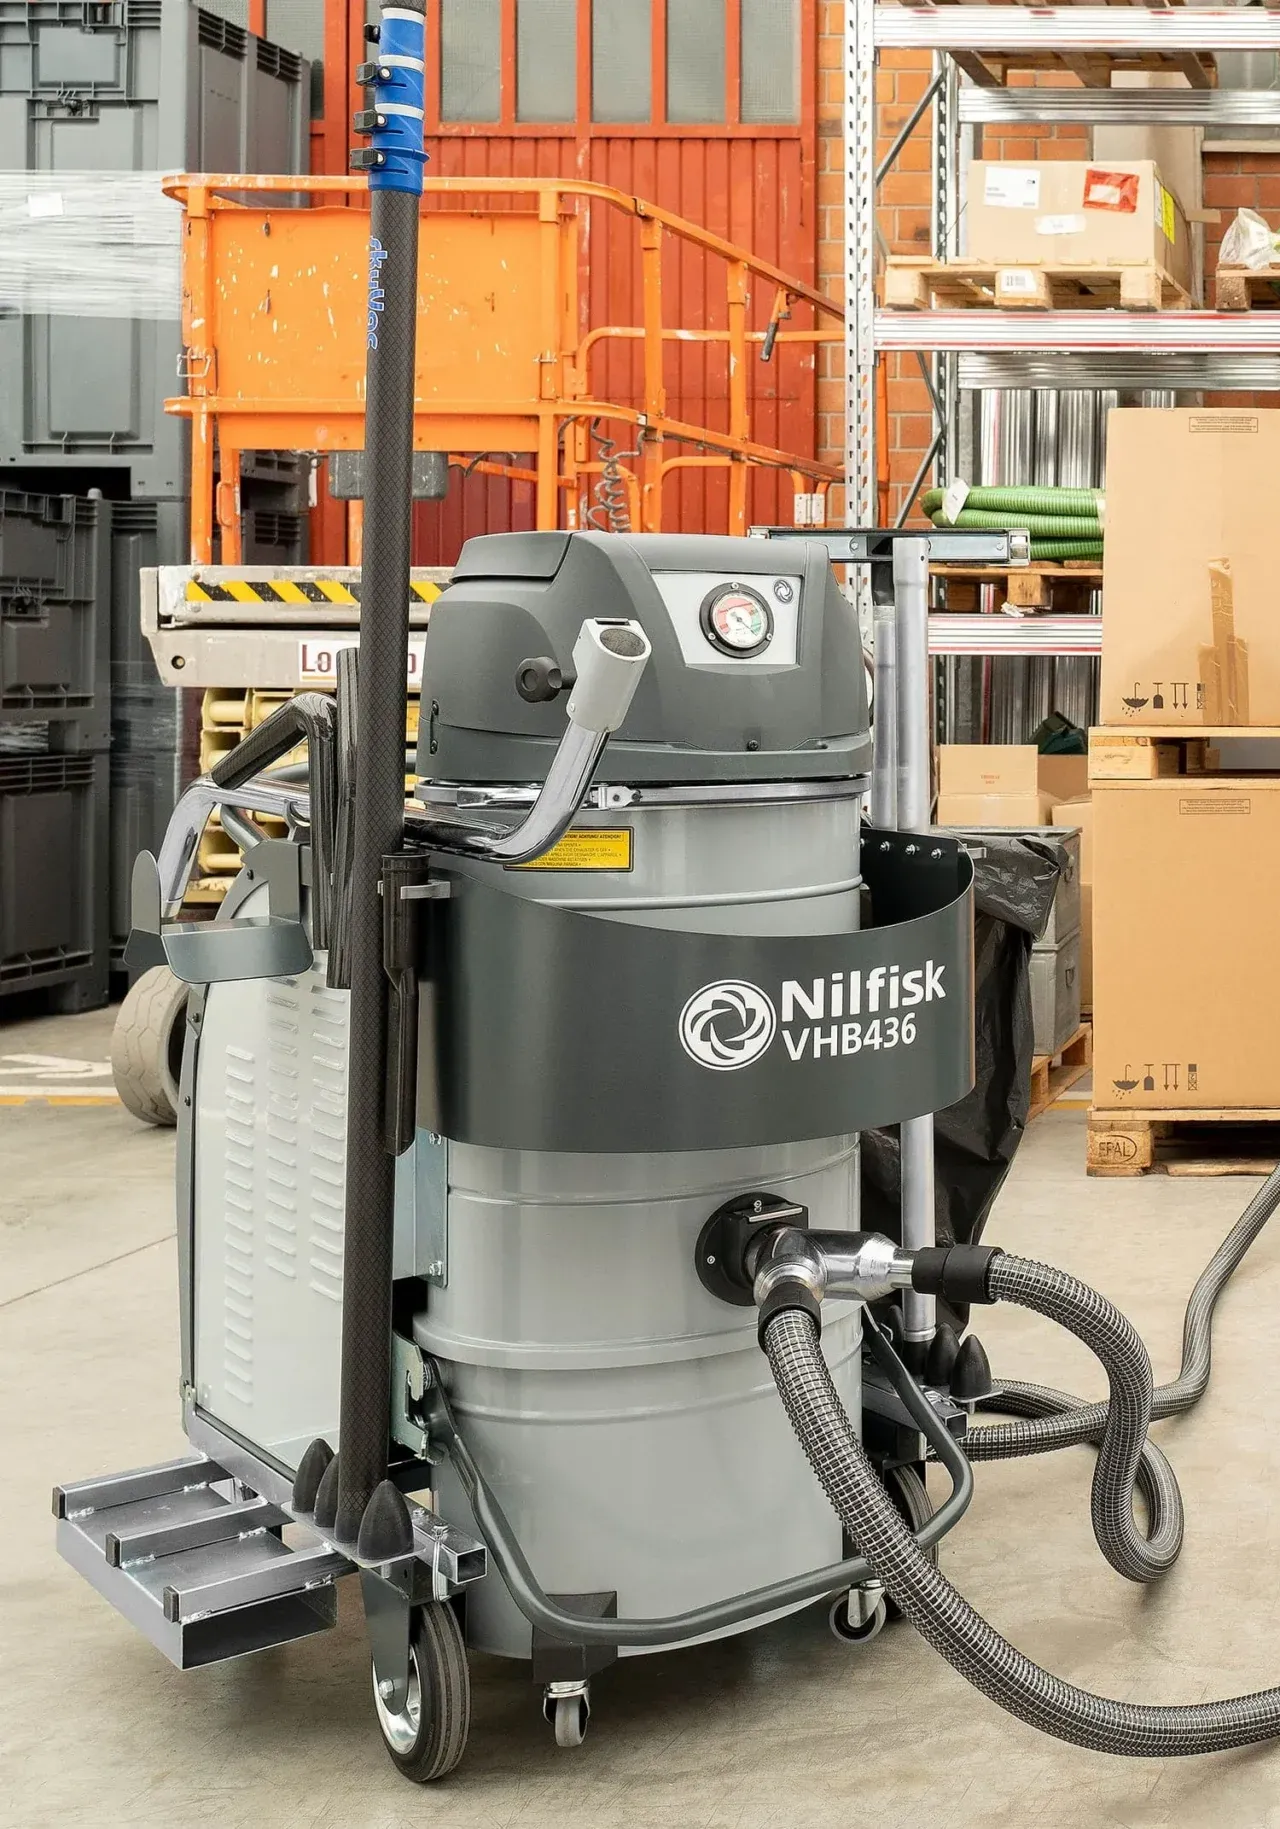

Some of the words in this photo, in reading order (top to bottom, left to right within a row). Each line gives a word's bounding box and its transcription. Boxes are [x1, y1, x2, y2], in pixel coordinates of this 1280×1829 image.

[781, 959, 947, 1022] Nilfisk
[781, 1012, 917, 1061] VHB436
[1098, 1141, 1131, 1158] EPAL
